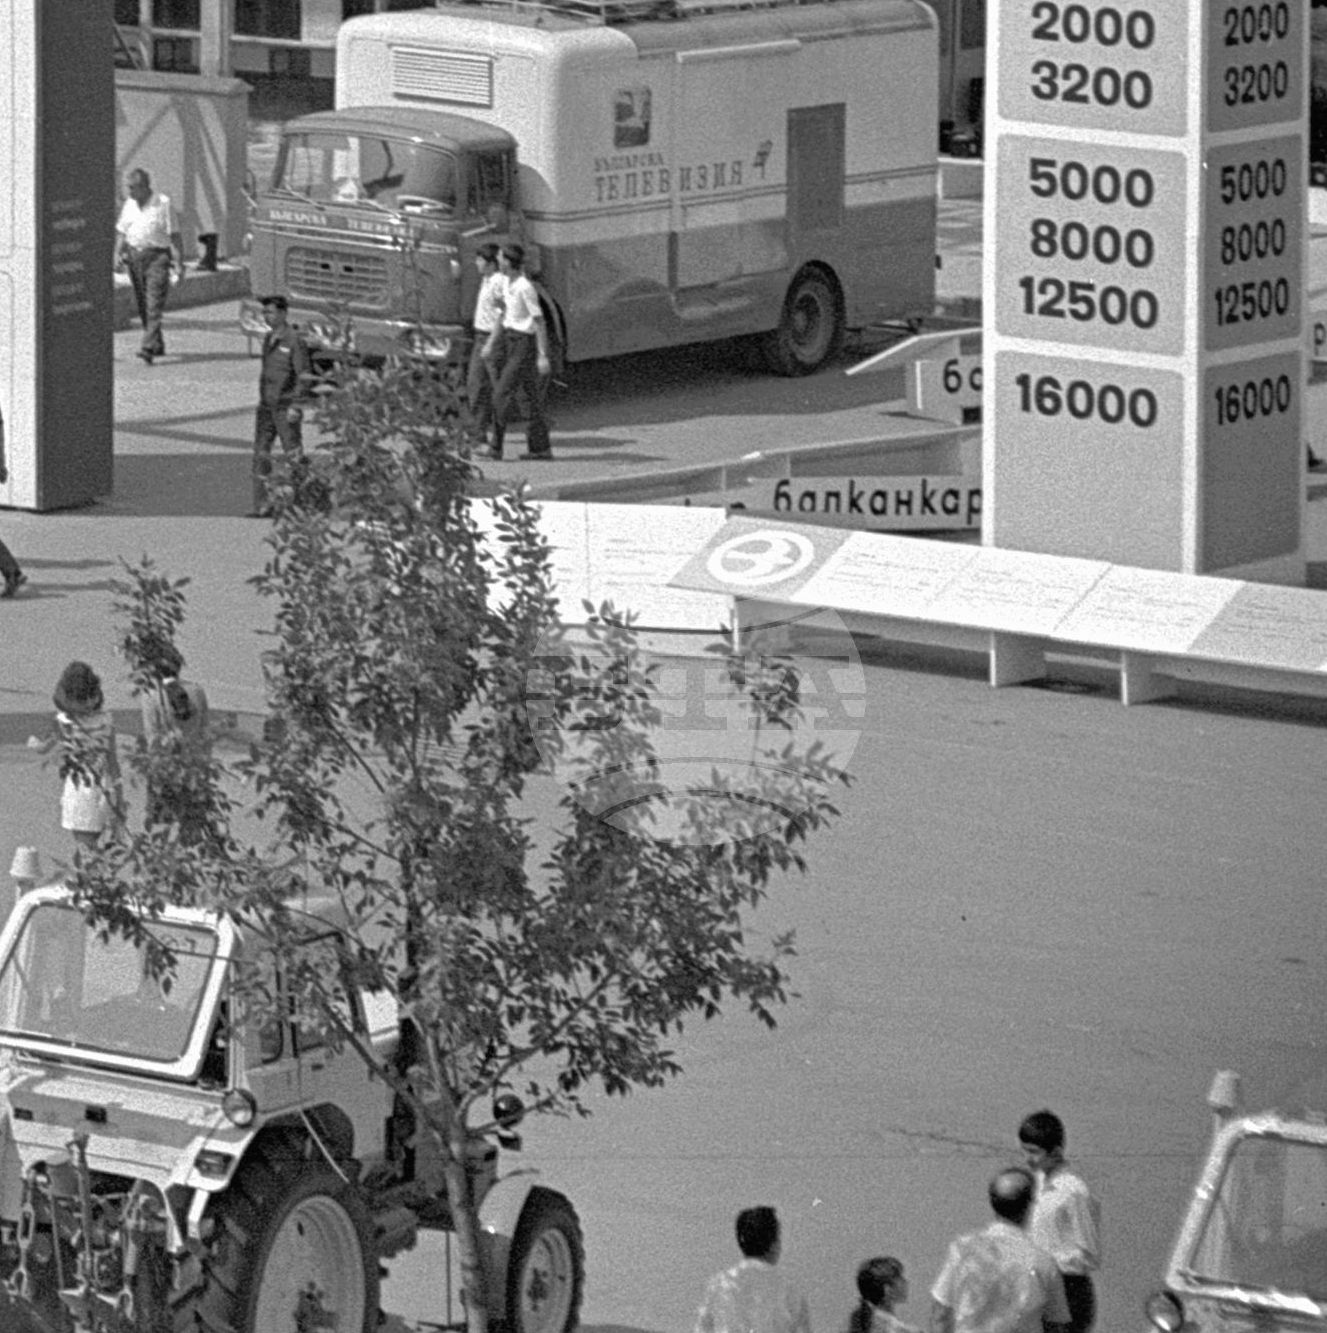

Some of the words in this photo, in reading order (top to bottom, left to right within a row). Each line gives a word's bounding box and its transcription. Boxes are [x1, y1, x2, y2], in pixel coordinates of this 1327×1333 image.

[1032, 1, 1155, 50] 2000
[1224, 1, 1289, 47] 2000
[1031, 60, 1153, 110] 3200
[1224, 60, 1288, 107] 3200
[1030, 157, 1154, 208] 5000
[1221, 158, 1286, 205] 5000
[1030, 218, 1154, 269] 8000
[1220, 218, 1286, 266] 8000
[1019, 276, 1159, 330] 12500
[1216, 277, 1289, 326] 12500
[1015, 373, 1158, 428] 16000
[1215, 374, 1291, 425] 16000
